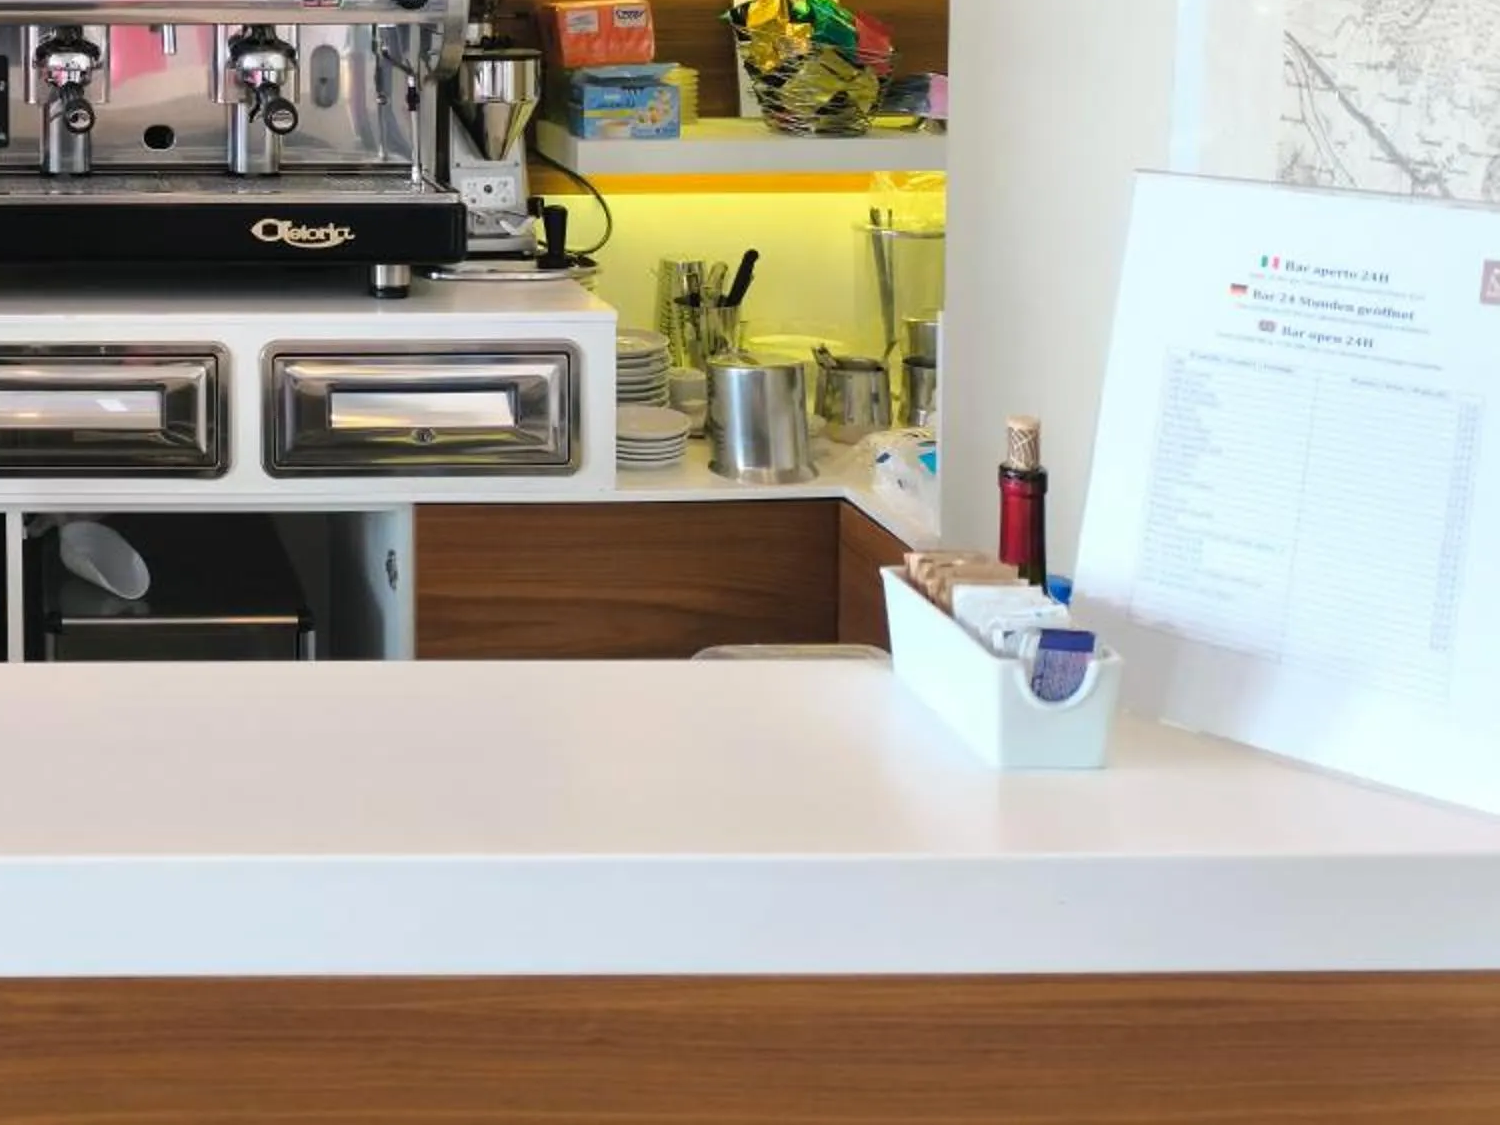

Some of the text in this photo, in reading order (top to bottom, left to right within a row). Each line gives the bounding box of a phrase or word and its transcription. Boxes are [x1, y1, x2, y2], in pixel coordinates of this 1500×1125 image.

[1285, 259, 1309, 273] Bar
[1253, 289, 1275, 302] Bar
[1281, 325, 1306, 338] Bar
